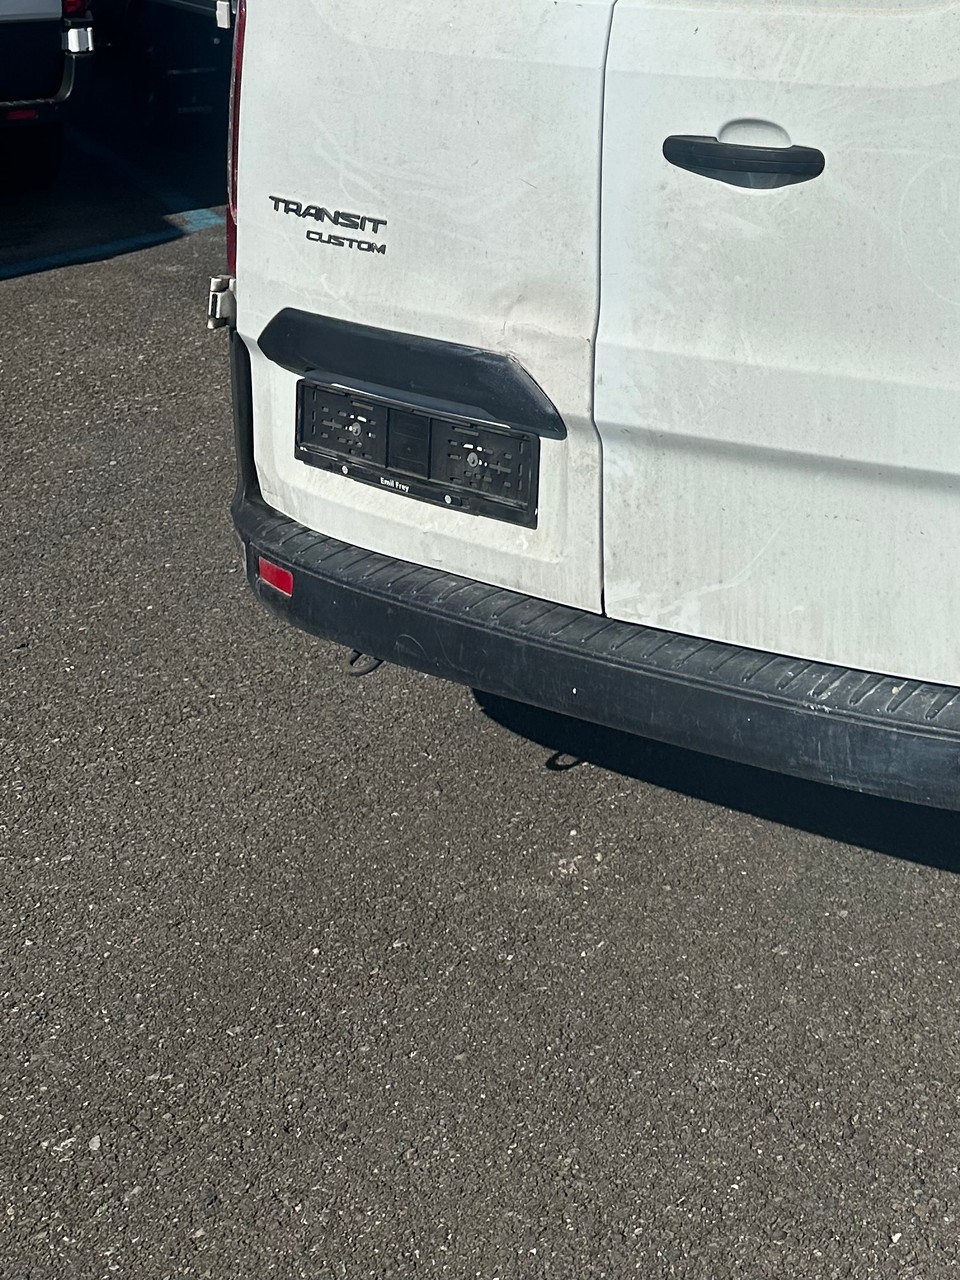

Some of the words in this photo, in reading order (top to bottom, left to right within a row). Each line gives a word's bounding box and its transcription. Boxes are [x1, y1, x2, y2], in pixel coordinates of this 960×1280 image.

[268, 195, 388, 234] TRANSIT
[305, 230, 387, 255] CUSTOM
[380, 476, 395, 488] Emil
[395, 480, 410, 493] Frey
